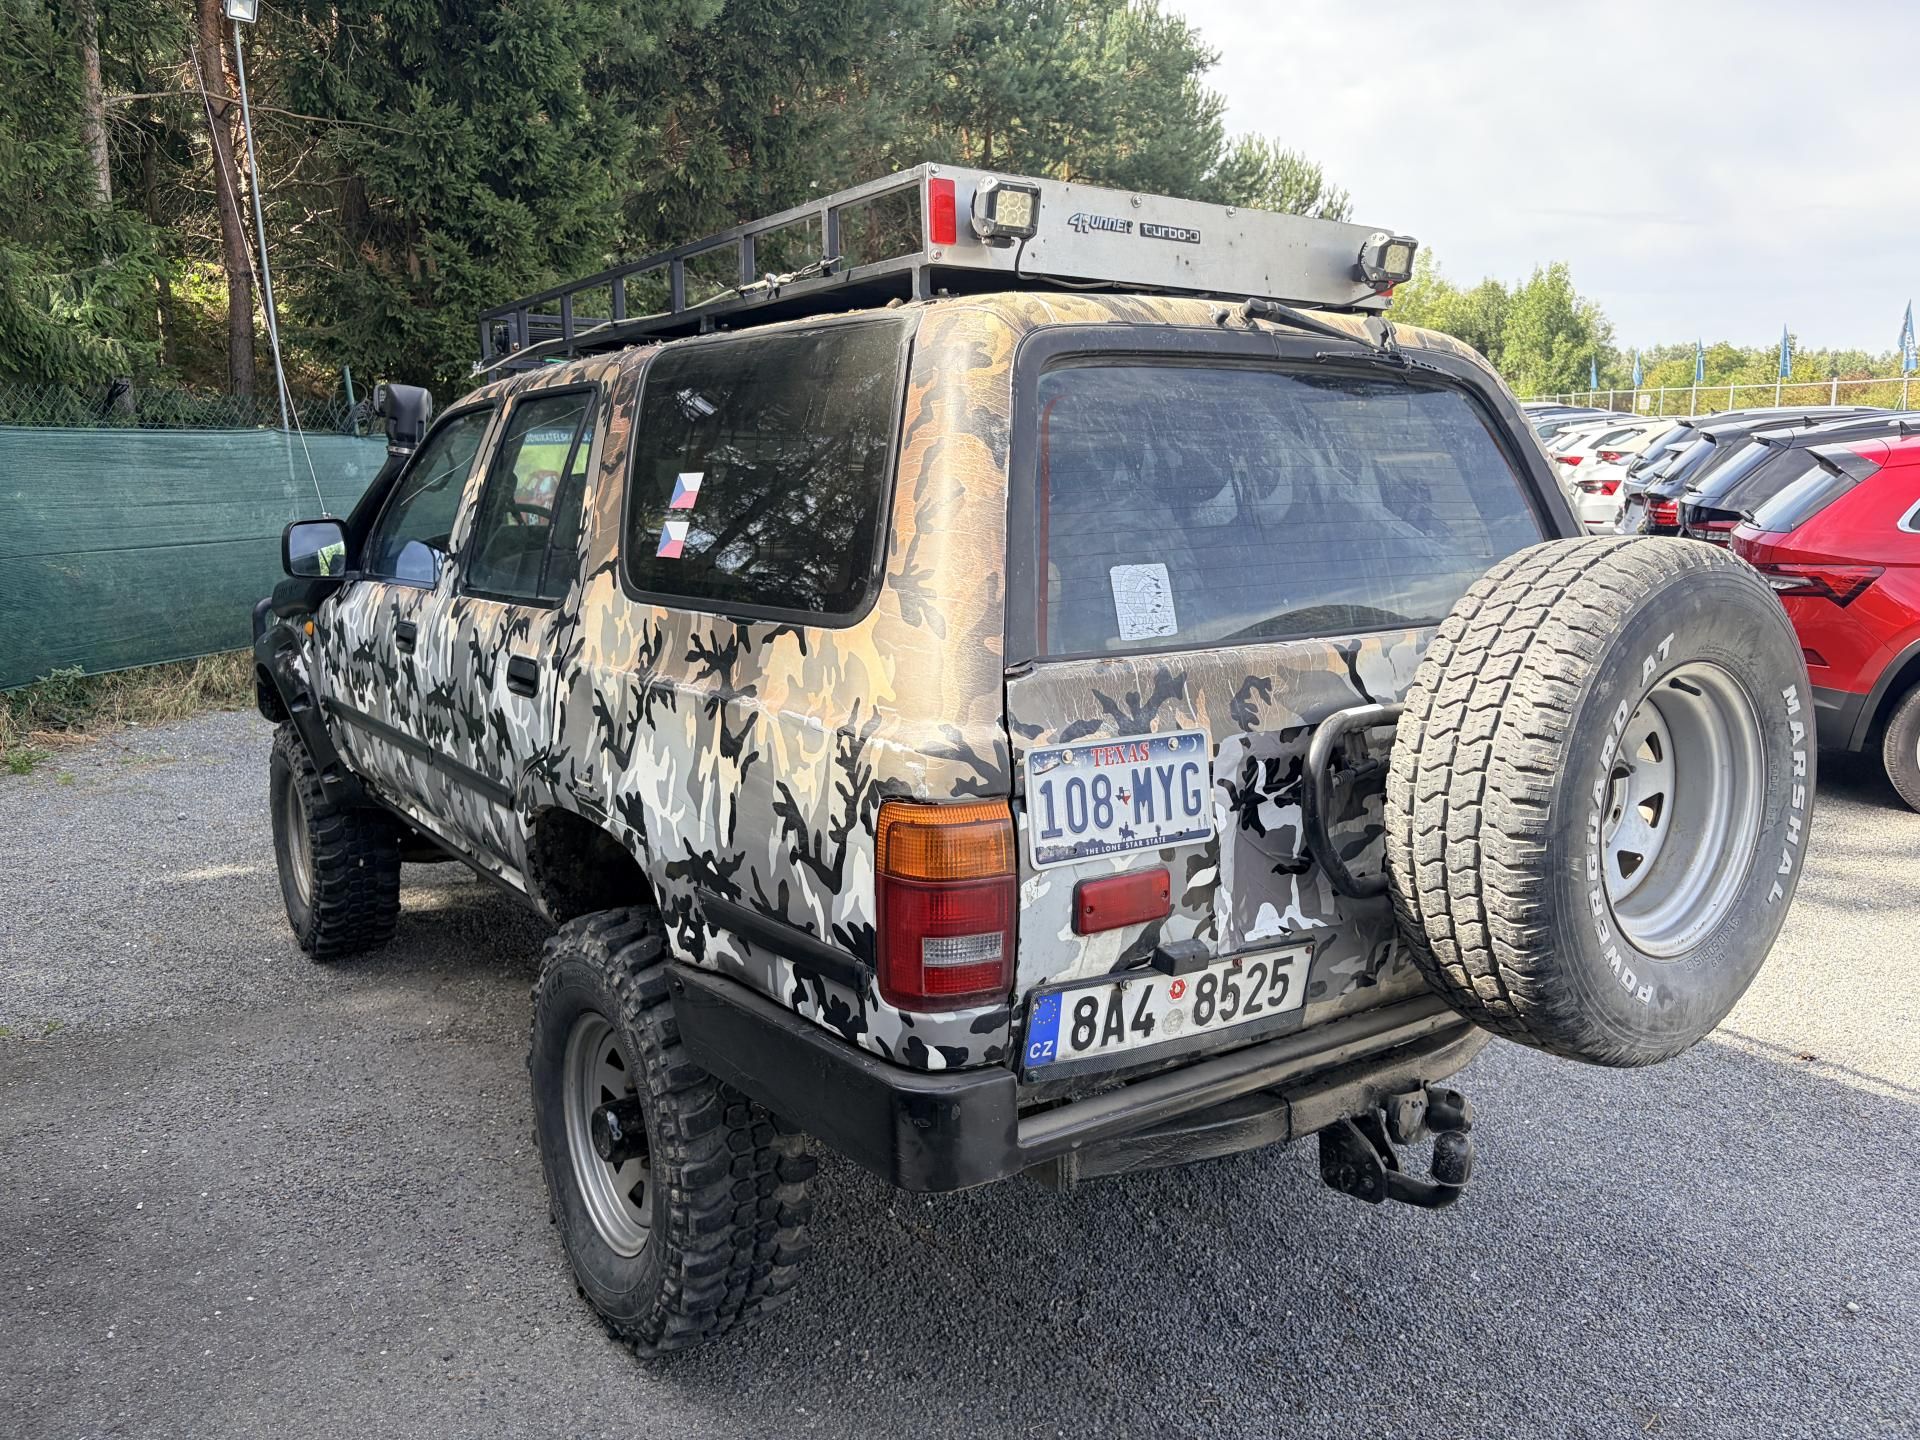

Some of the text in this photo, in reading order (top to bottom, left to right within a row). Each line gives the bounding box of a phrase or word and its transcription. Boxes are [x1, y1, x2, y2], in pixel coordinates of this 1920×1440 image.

[1641, 632, 1675, 687] AT
[1091, 742, 1150, 768] TEXAS
[1040, 761, 1201, 839] 108 MYG
[1767, 684, 1807, 904] MARSHAL
[1085, 836, 1167, 856] THE LONE STAR STATE
[1070, 955, 1294, 1051] 8A4 8525
[1029, 1040, 1053, 1059] CZ
